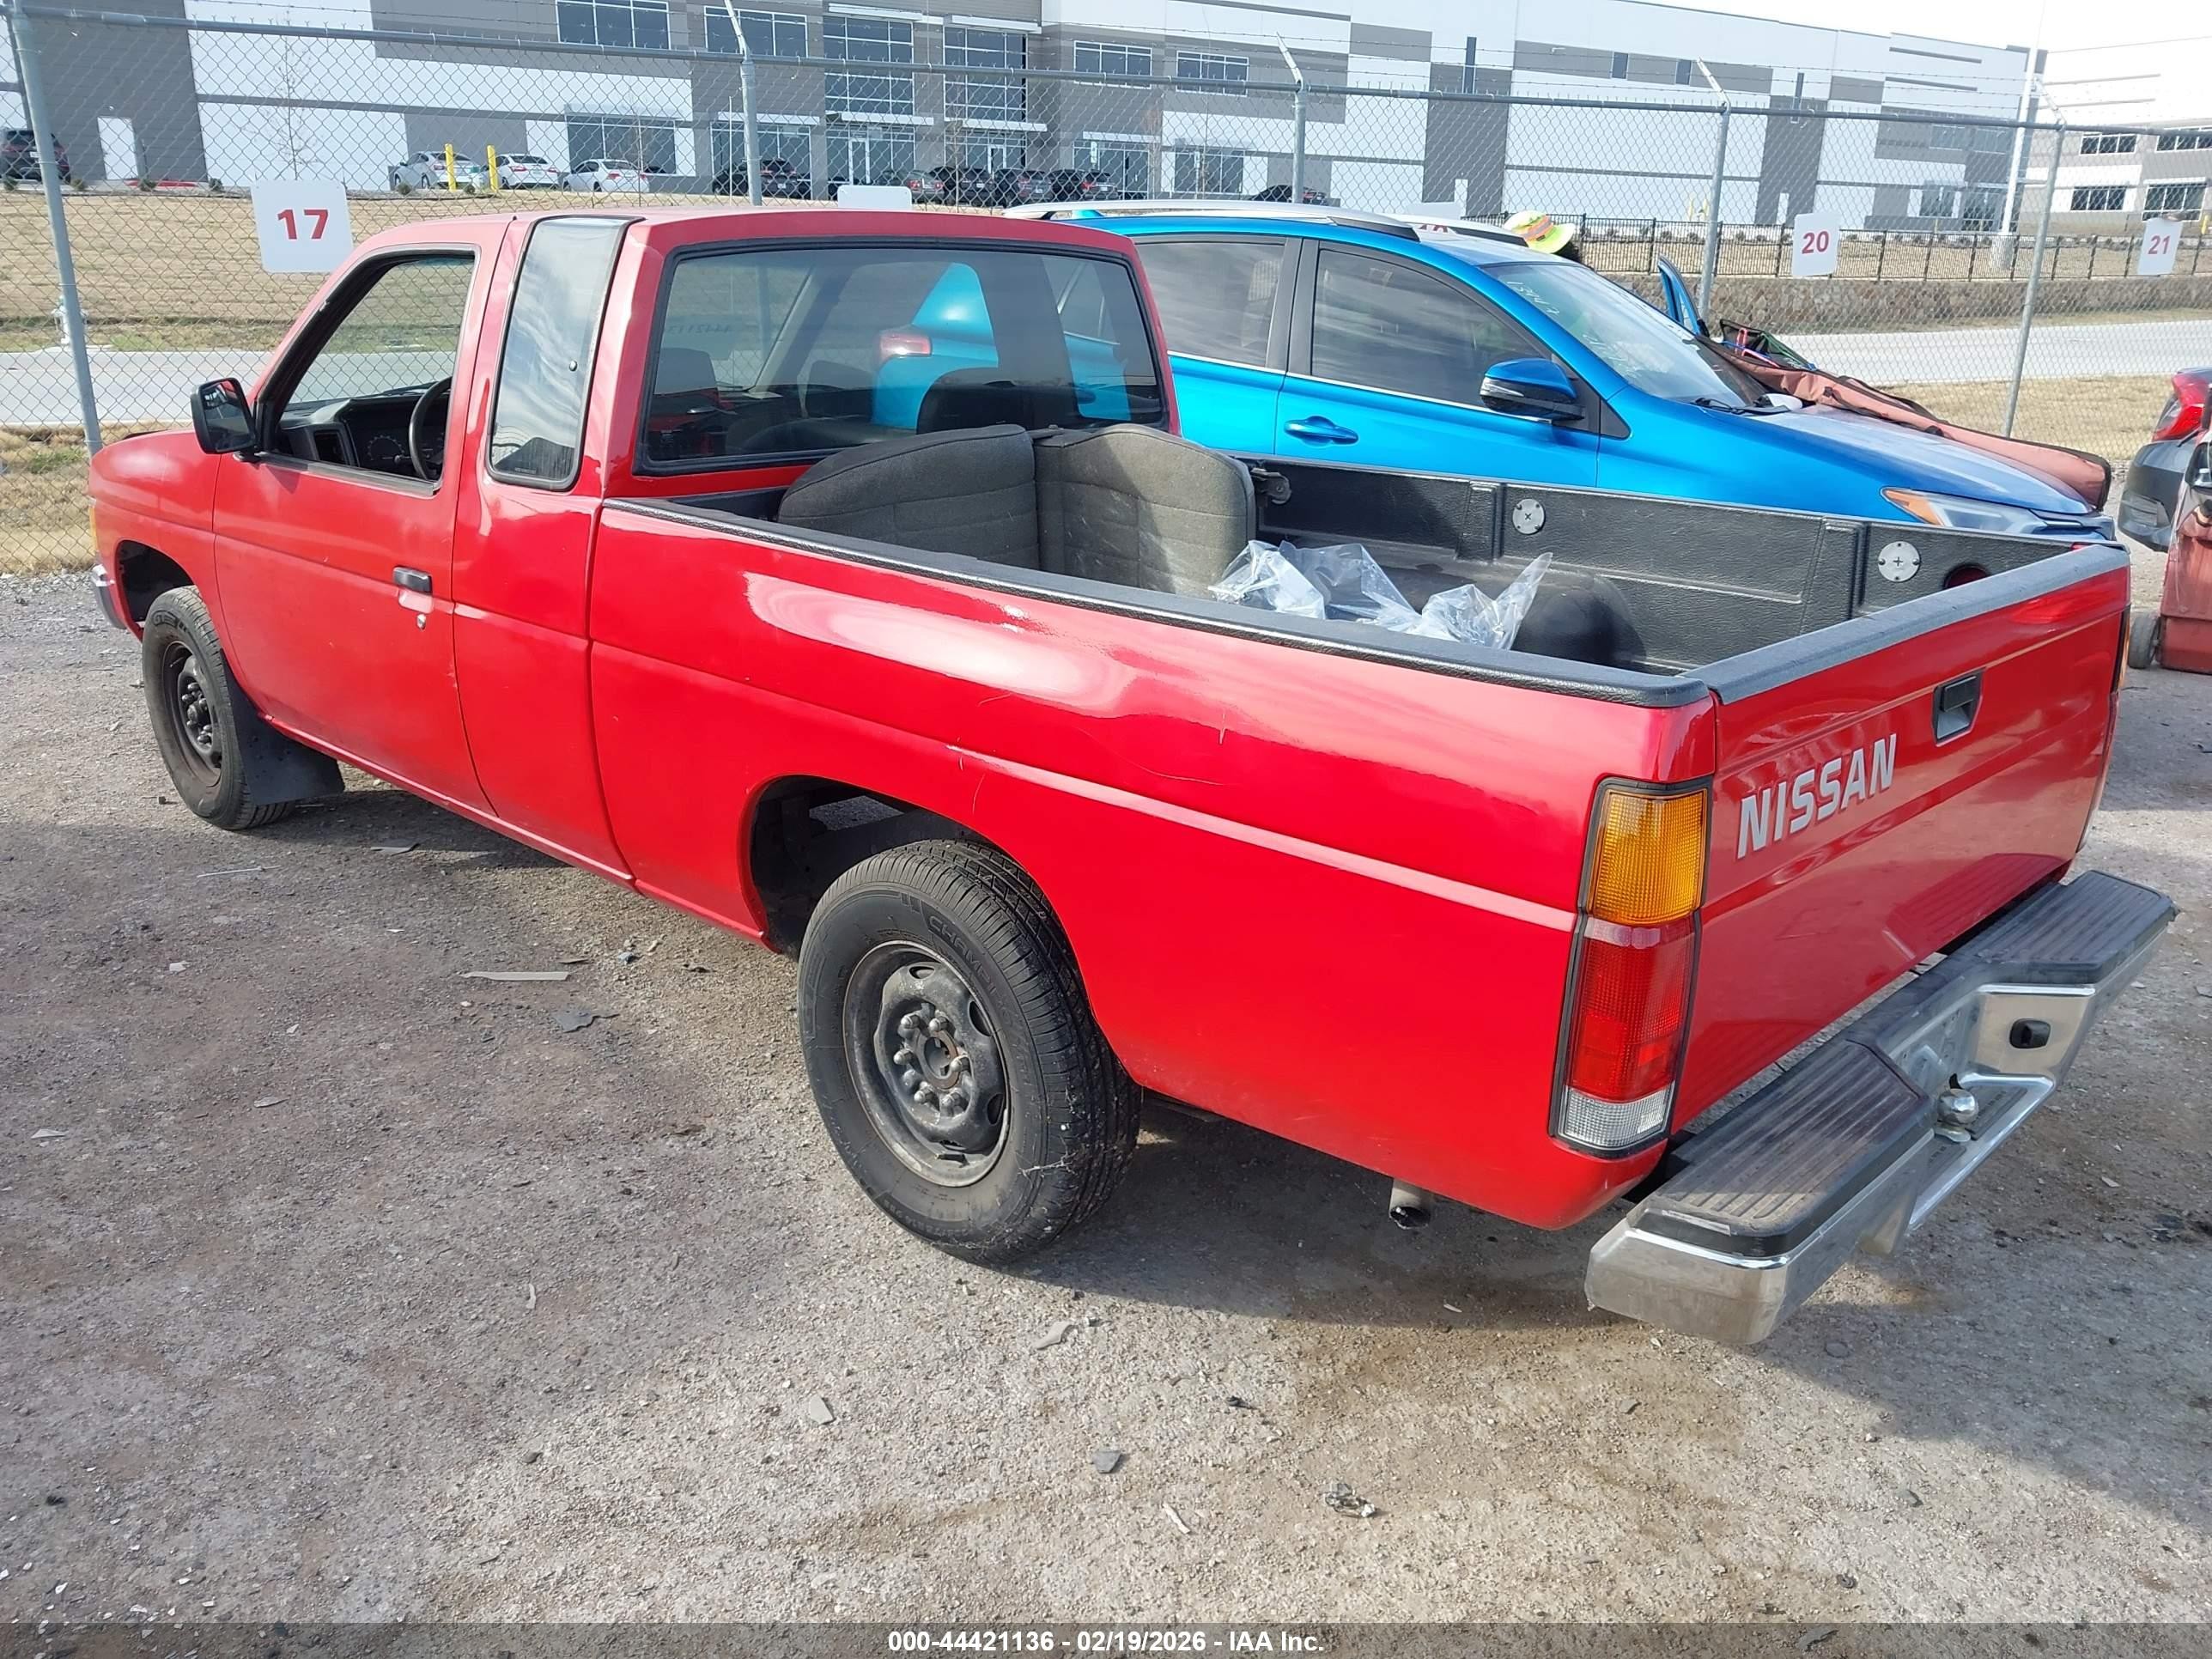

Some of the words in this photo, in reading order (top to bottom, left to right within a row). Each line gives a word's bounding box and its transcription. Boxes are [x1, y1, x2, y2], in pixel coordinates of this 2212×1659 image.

[279, 209, 328, 240] 17
[1802, 230, 1829, 254] 20
[2148, 234, 2170, 255] 21
[1737, 733, 1897, 859] NISSAN
